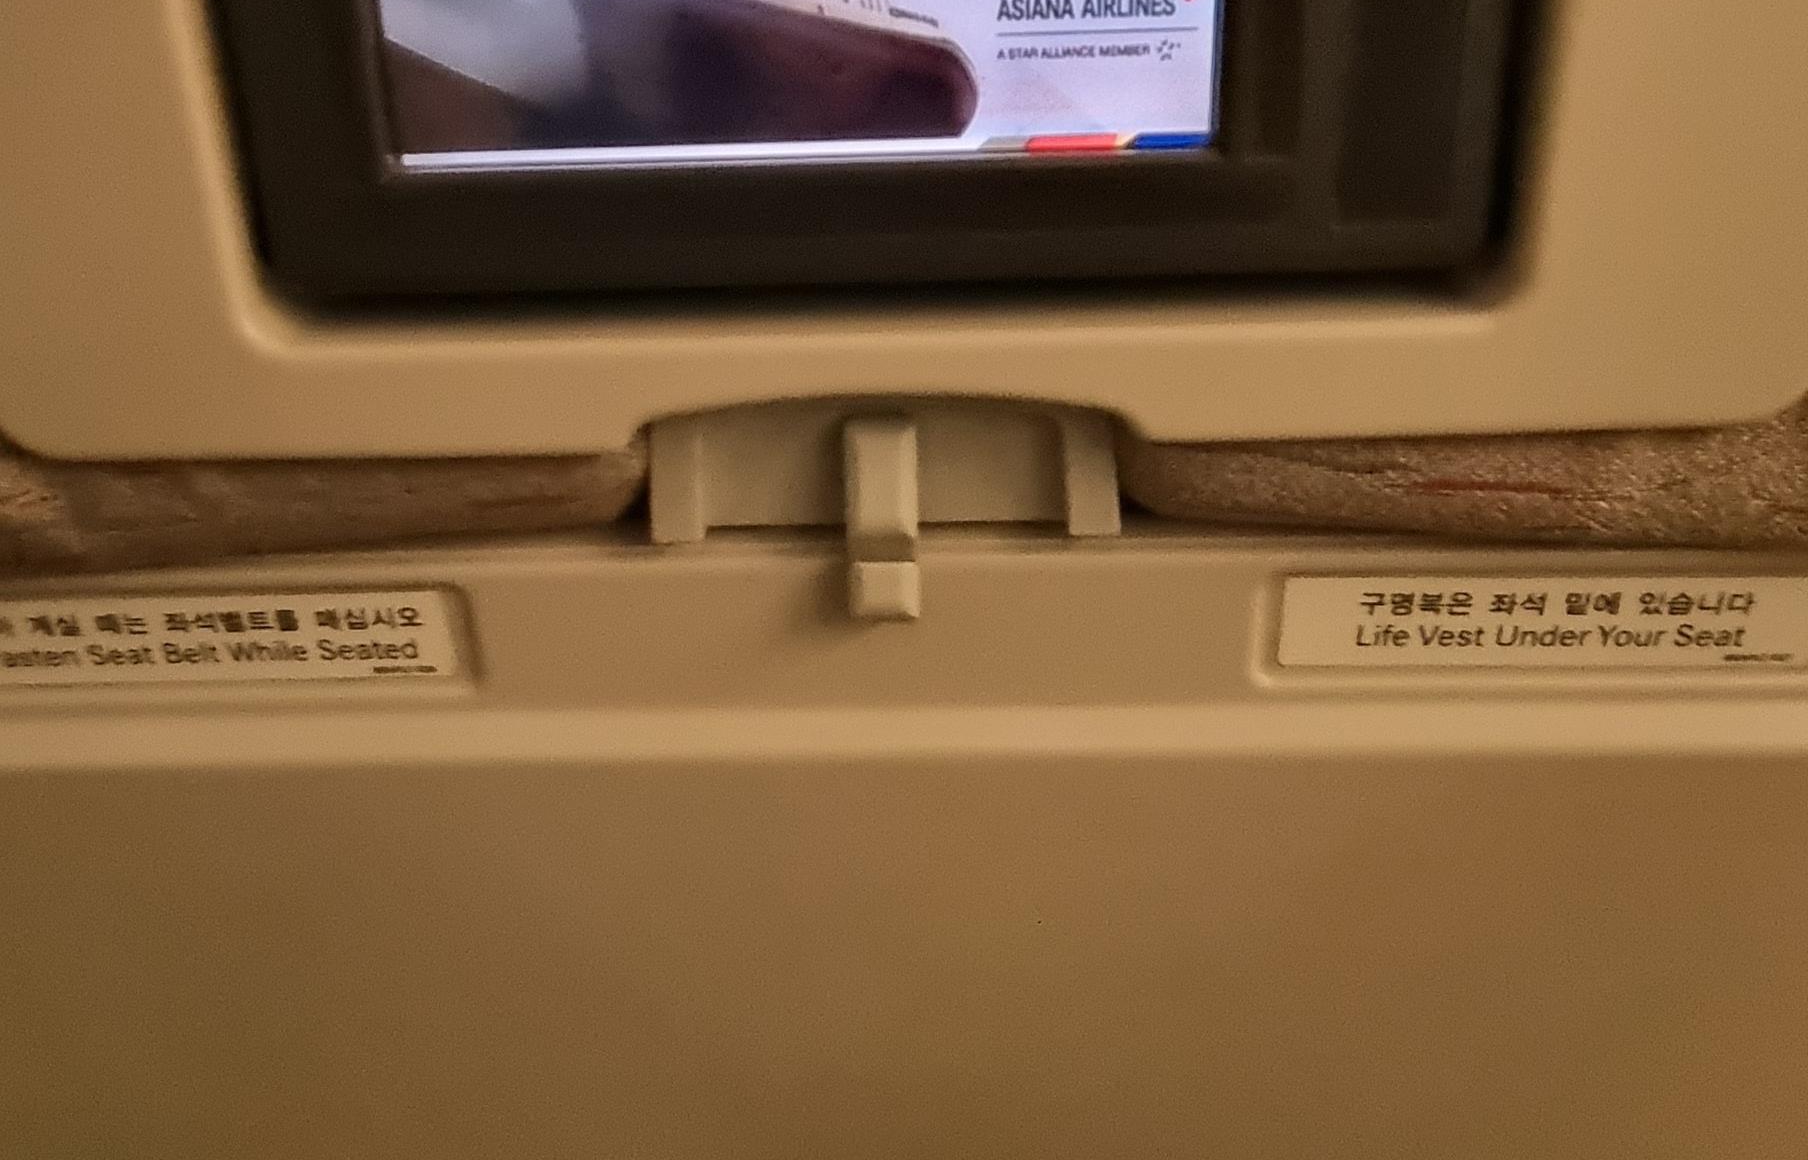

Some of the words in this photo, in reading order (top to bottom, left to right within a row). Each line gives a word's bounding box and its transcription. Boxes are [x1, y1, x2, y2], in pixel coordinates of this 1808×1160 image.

[996, 49, 1006, 61] A
[1008, 44, 1039, 60] STAR
[1040, 44, 1096, 59] ALLIANCE
[1098, 43, 1151, 58] MEMBER
[1360, 591, 1474, 617] 구명복은
[1487, 592, 1549, 617] 좌석
[1564, 591, 1622, 616] 밑에
[1638, 591, 1757, 616] 있습니다
[1355, 624, 1411, 647] Life
[1417, 623, 1486, 647] Vest
[1495, 623, 1592, 648] Under
[1598, 624, 1668, 648] Your
[1673, 623, 1747, 648] Seat
[0, 648, 81, 668] asten
[86, 643, 154, 667] Seat
[162, 641, 220, 665] Belt
[226, 639, 309, 662] While
[316, 637, 419, 661] Seated
